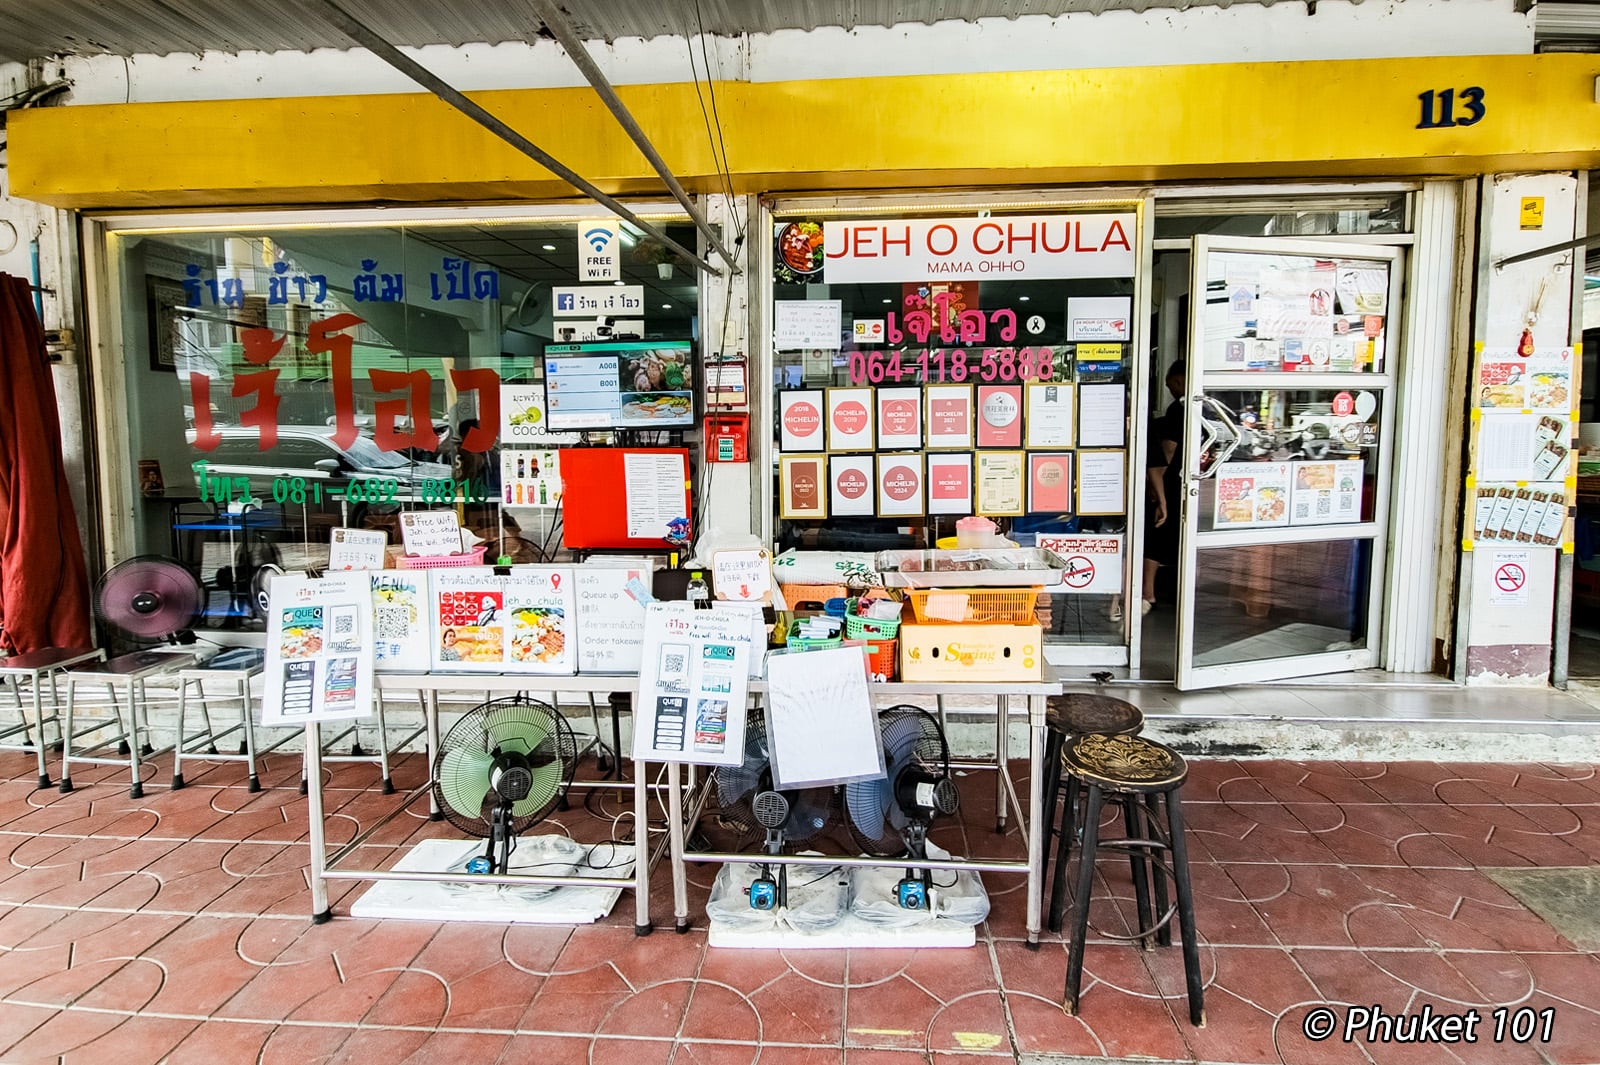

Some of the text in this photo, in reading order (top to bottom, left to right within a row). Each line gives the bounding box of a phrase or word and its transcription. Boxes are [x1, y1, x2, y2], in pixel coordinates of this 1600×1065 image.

[1416, 86, 1486, 129] 113
[826, 220, 1131, 259] JEH O CHULA
[587, 257, 612, 265] FREE
[588, 268, 611, 277] Wi Fi
[927, 260, 1025, 273] MAMA OHHO
[181, 256, 499, 309] ร้าน ข้าว ต้ม เป็ด
[888, 292, 1017, 344] เจ๊โอว
[849, 347, 1054, 384] 064-118-5888
[272, 477, 400, 505] 081-682
[422, 477, 489, 505] 8816
[370, 575, 410, 592] MENU
[581, 591, 619, 600] Queue up
